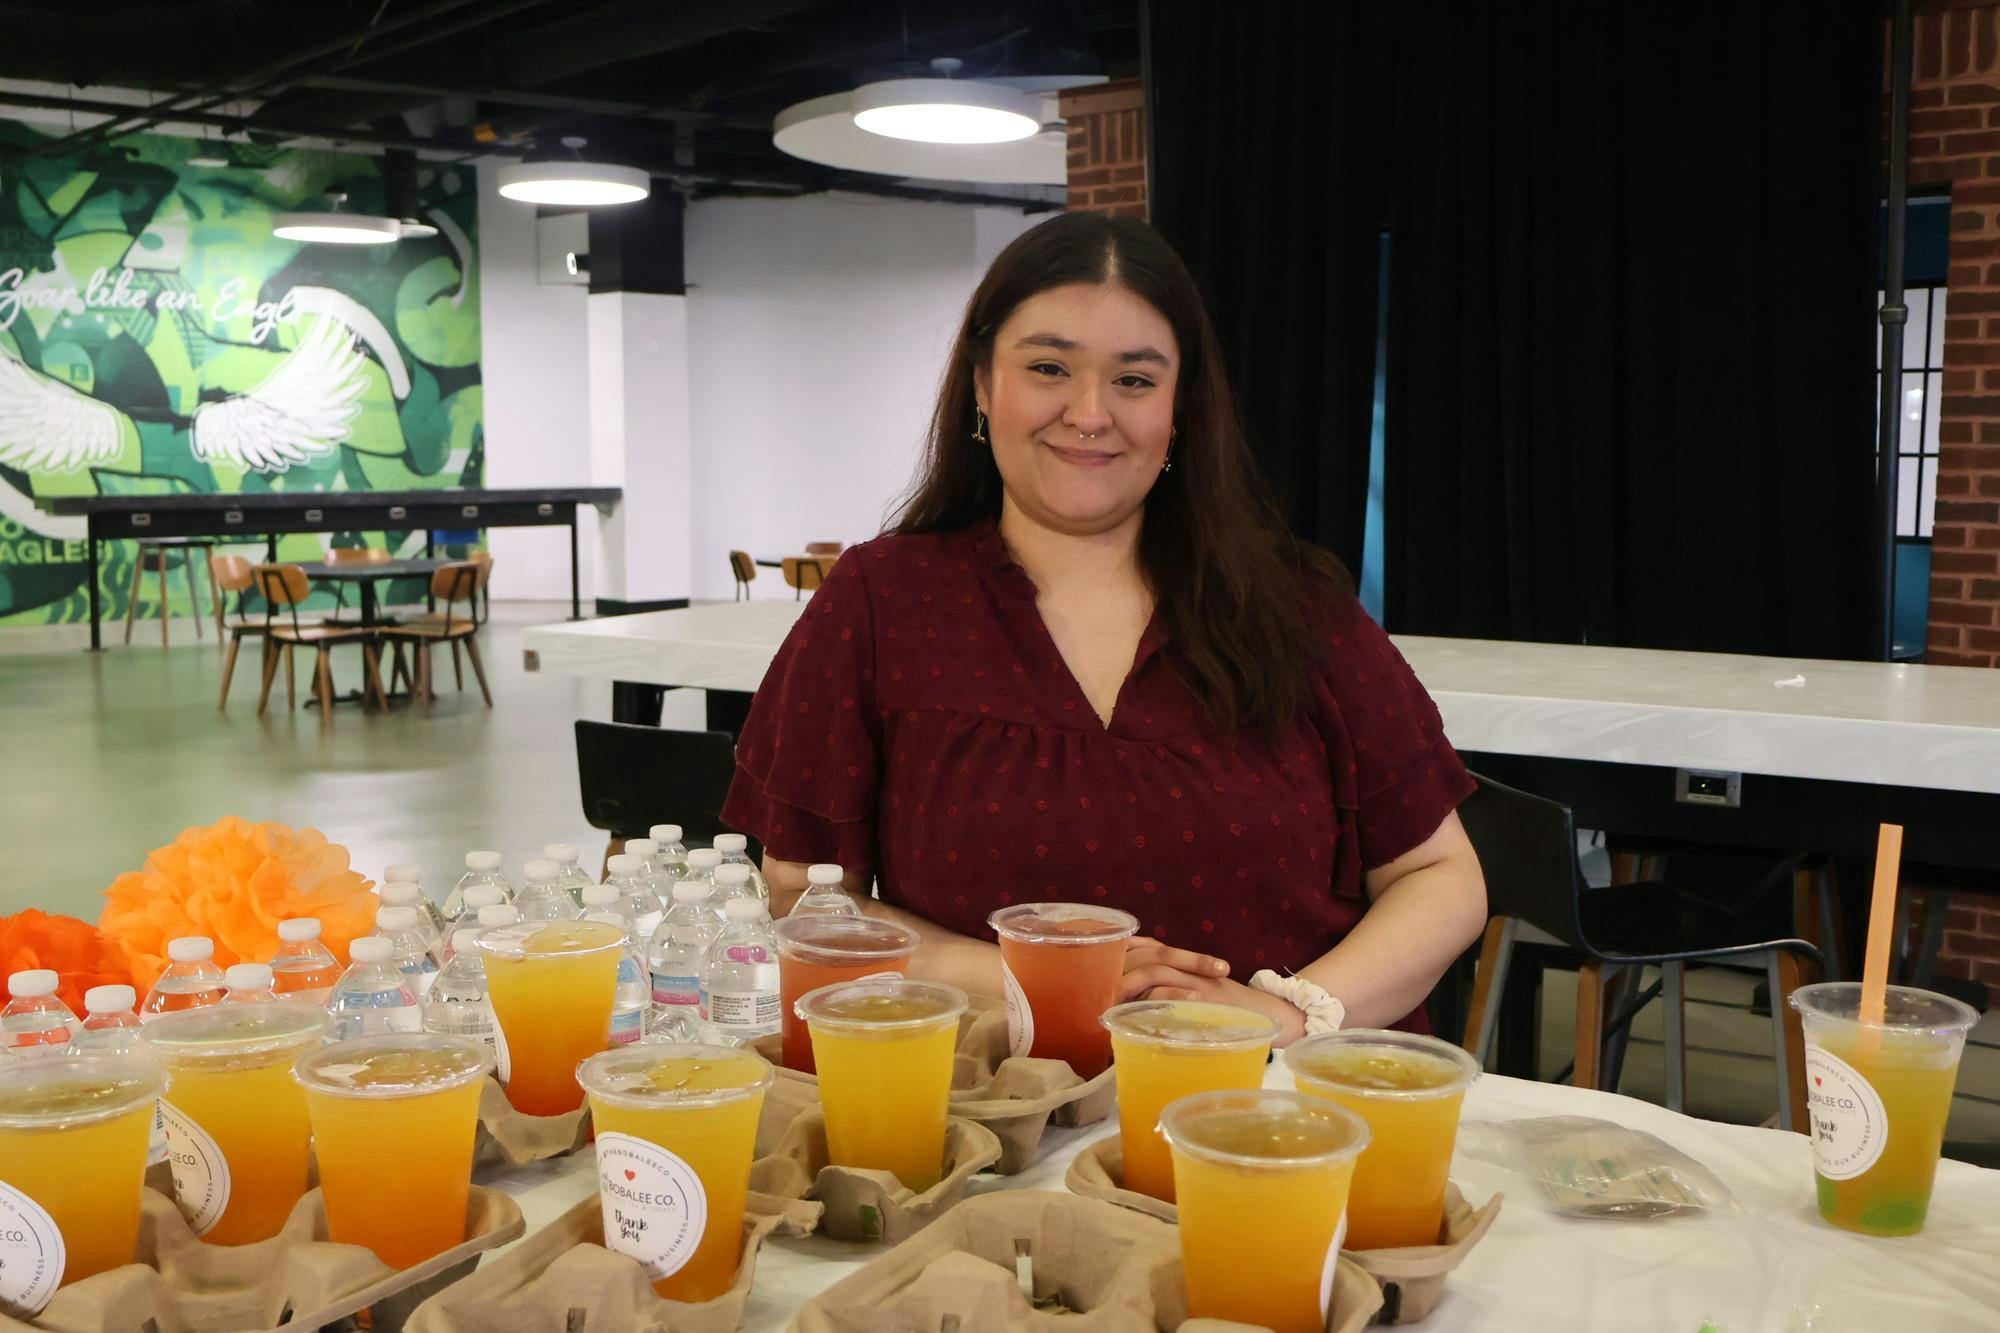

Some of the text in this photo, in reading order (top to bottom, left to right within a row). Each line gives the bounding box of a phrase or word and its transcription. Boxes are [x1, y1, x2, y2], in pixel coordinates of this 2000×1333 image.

[85, 266, 149, 308] like
[155, 290, 203, 311] an
[1837, 1098, 1856, 1109] CO.
[654, 1194, 676, 1207] CO.
[615, 1208, 649, 1230] thank
[620, 1225, 641, 1243] you
[658, 1221, 689, 1262] BUSINESS
[20, 1258, 46, 1301] BUSINESS
